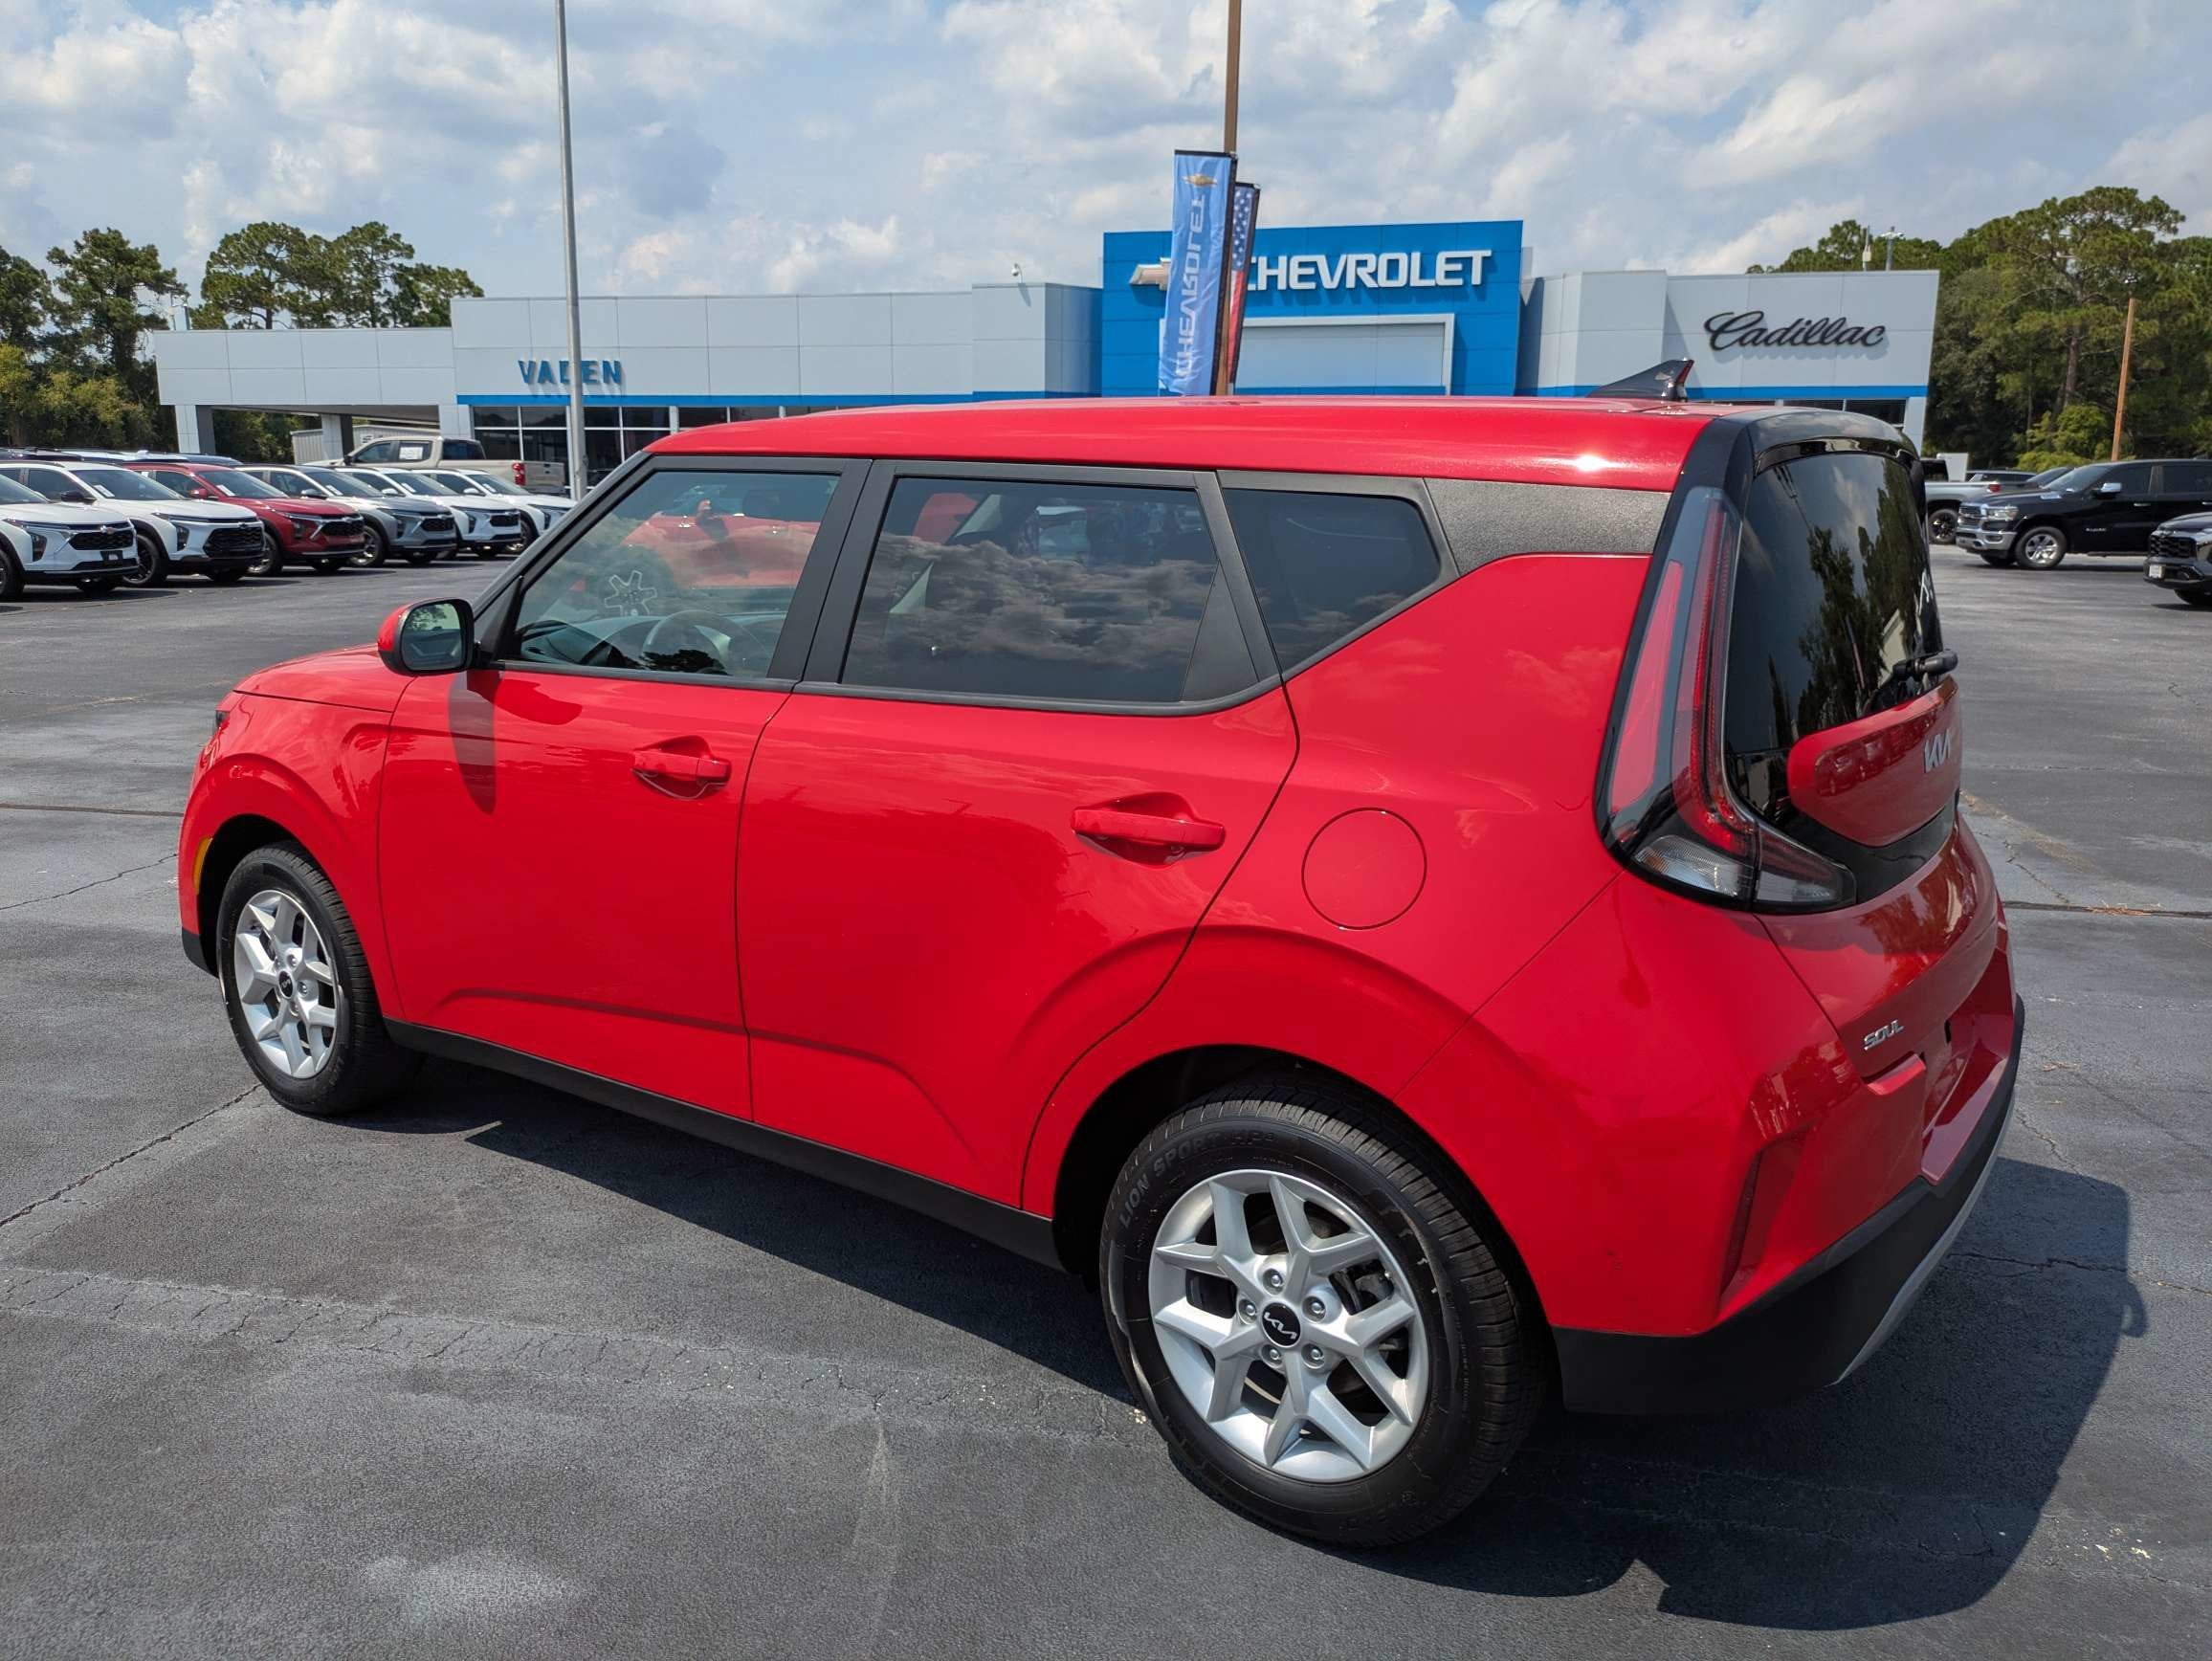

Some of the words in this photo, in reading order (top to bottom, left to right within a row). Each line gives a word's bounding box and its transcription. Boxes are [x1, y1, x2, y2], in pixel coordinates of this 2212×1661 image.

[1704, 311, 1886, 350] Cadillac
[1864, 1019, 1904, 1051] SOUL
[1118, 1173, 1149, 1229] LION
[1154, 1132, 1221, 1177] SPORT
